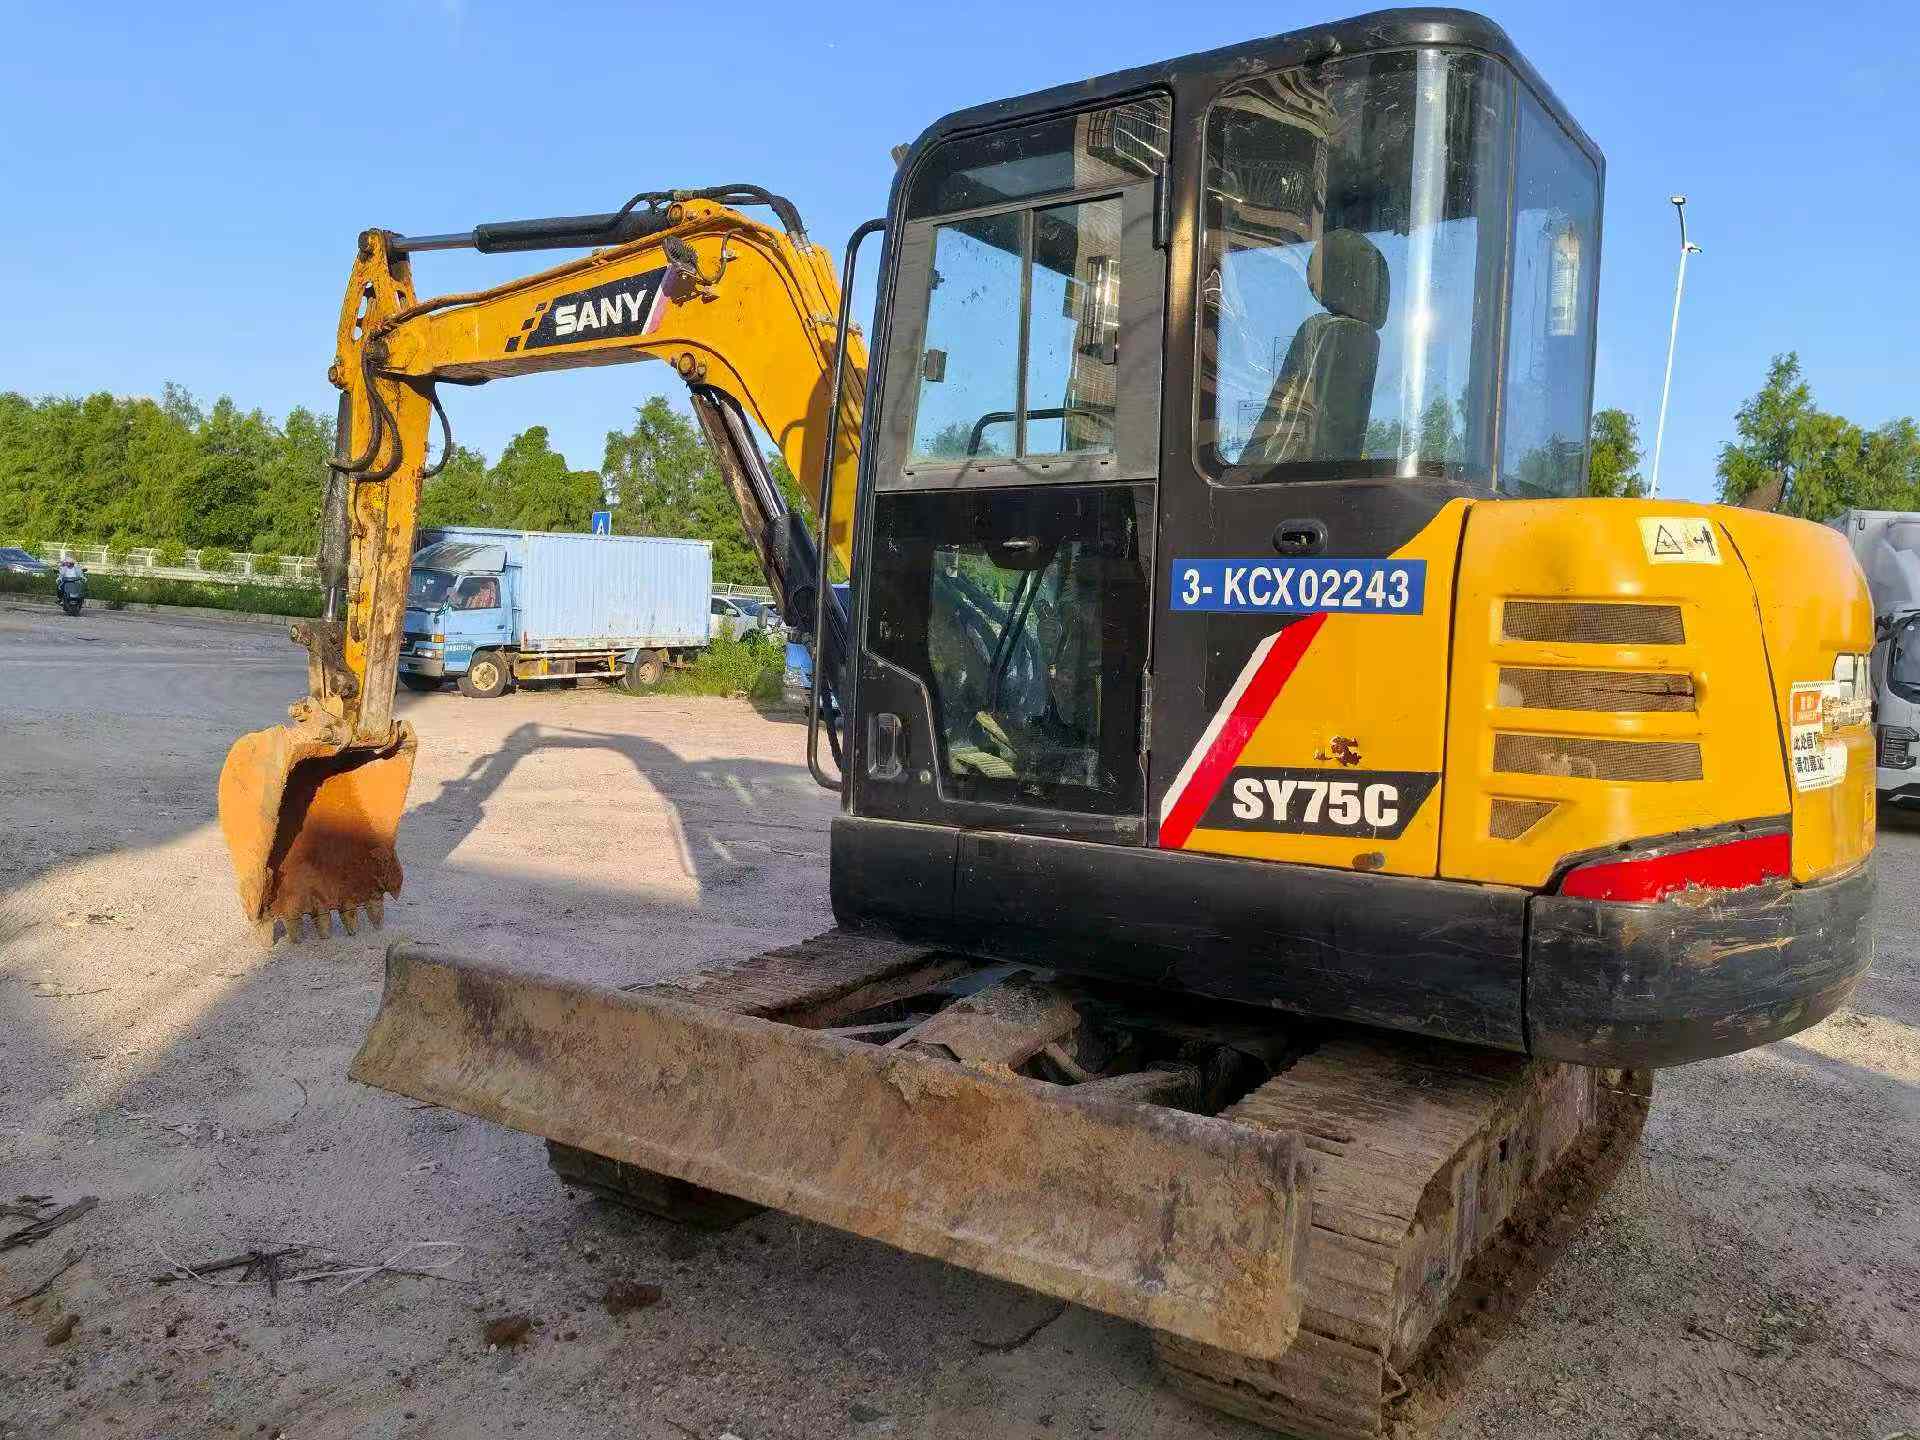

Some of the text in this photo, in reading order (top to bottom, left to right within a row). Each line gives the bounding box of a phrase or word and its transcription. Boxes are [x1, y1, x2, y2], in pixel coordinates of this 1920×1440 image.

[555, 289, 648, 336] SANY
[1223, 567, 1409, 608] KCX02243
[1232, 777, 1399, 827] SY75C
